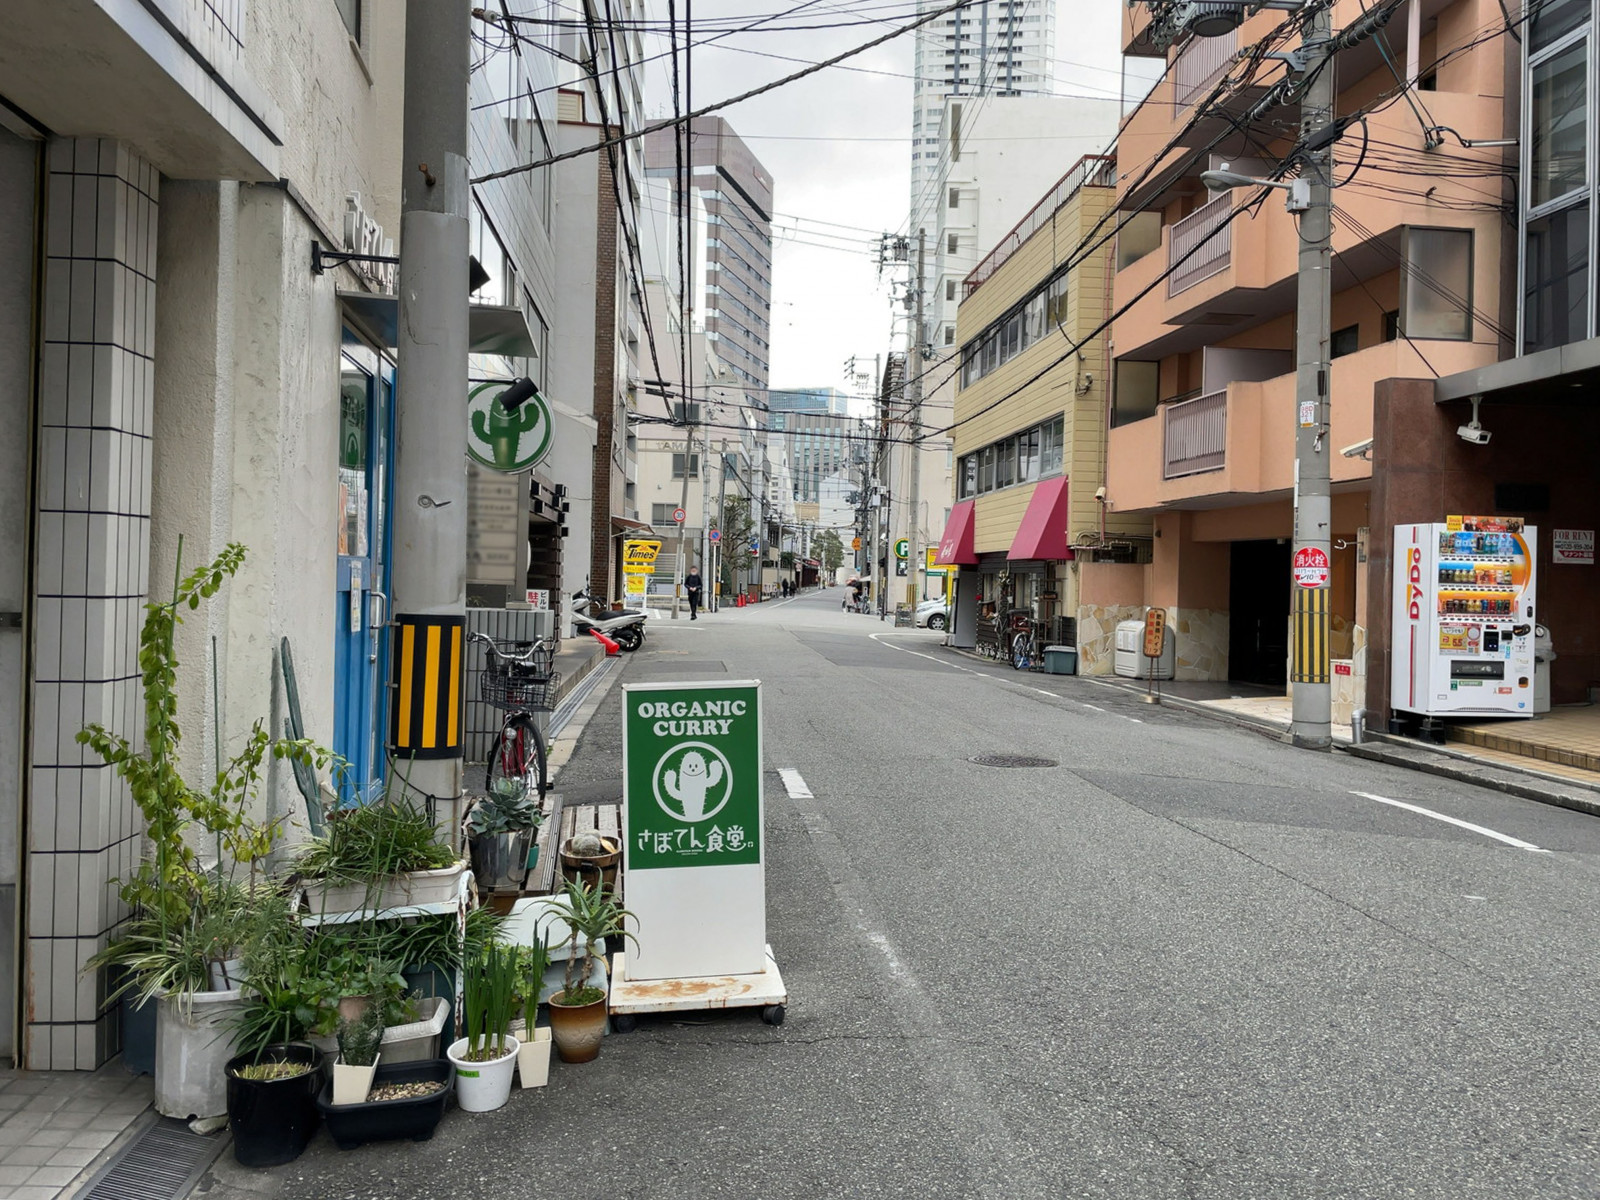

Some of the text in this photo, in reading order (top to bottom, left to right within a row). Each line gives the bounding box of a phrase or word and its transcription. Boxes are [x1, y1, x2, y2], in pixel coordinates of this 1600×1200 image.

[1555, 531, 1593, 541] FOR RENT
[628, 548, 655, 559] Times
[1296, 554, 1325, 567] 消火栓
[1410, 547, 1423, 619] DyDo
[637, 700, 747, 718] ORGANIC
[653, 719, 734, 737] CURRY
[638, 824, 747, 854] さぼてん食堂
